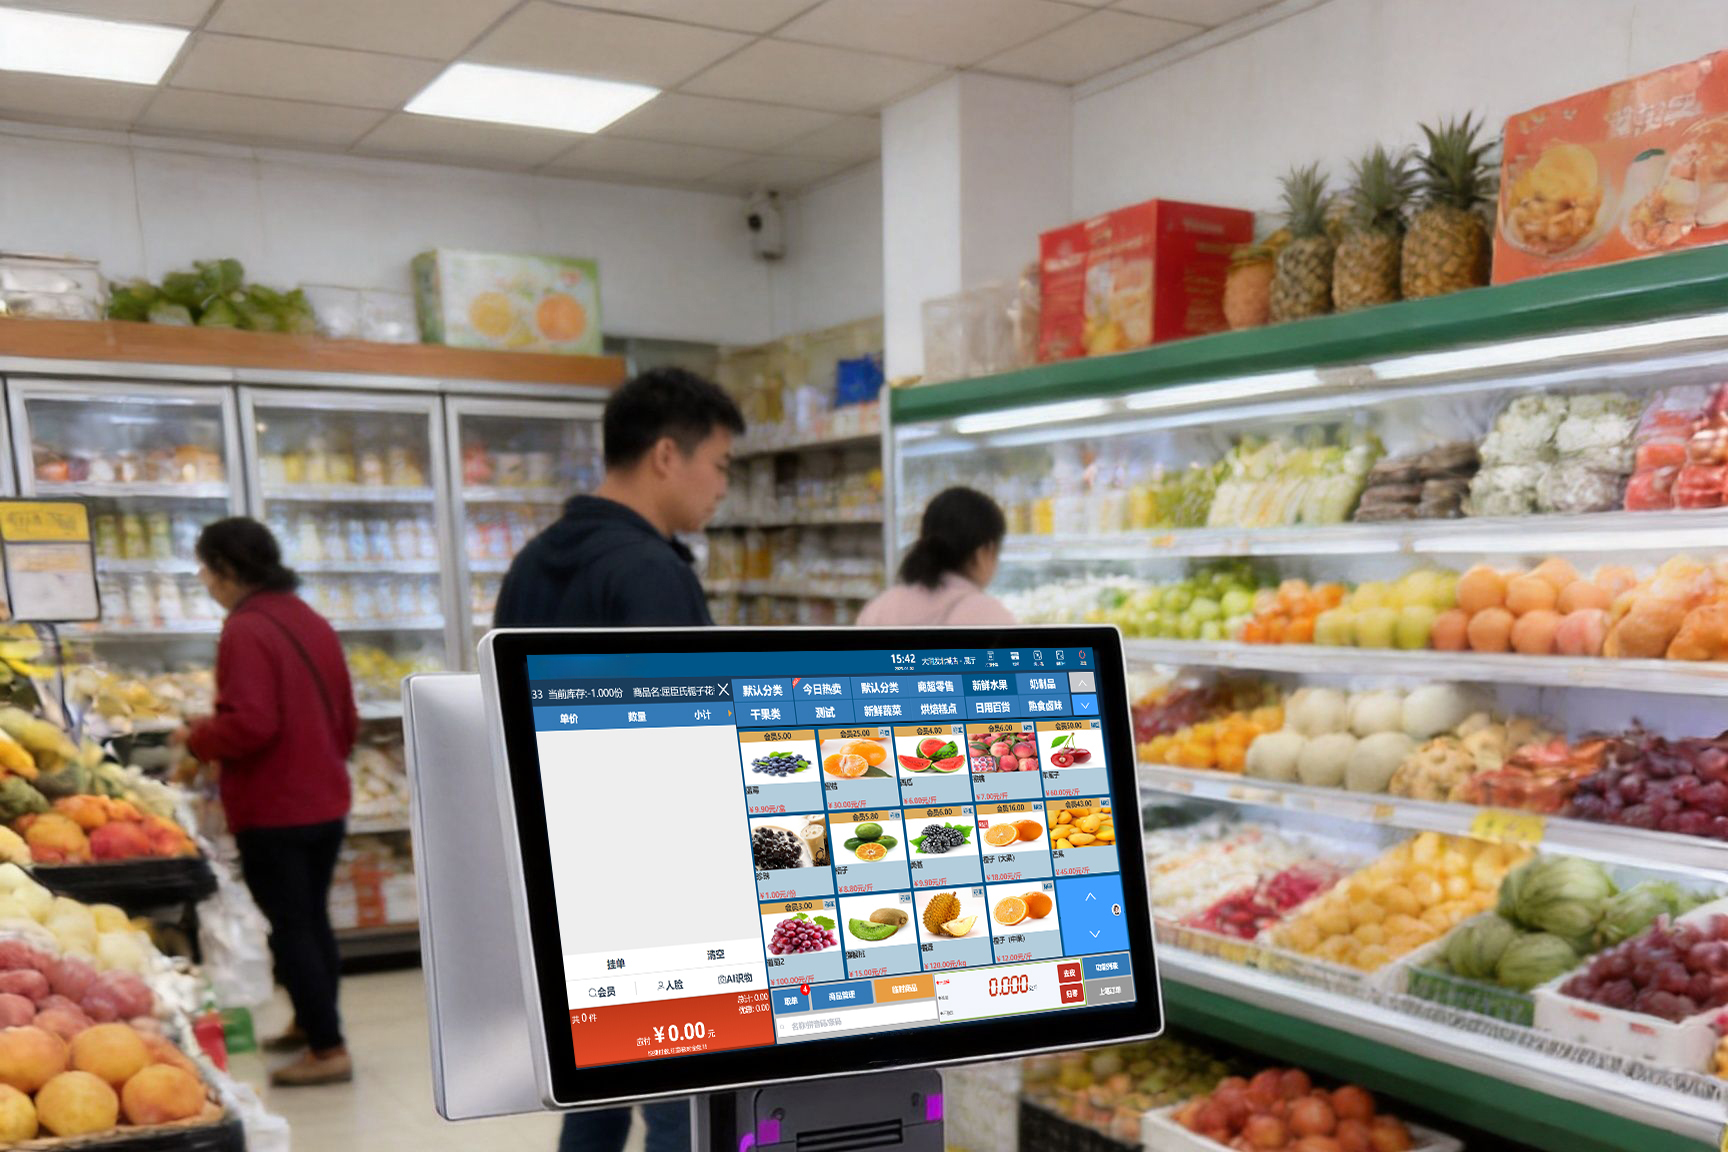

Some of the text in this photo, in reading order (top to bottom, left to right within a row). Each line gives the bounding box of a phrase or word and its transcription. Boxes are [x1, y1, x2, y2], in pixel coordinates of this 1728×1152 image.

[890, 654, 916, 664] 15:42
[802, 682, 842, 696] 今日热卖
[860, 682, 900, 694] 默认分类
[918, 680, 954, 693] 商超零售
[972, 679, 1008, 691] 新鲜水果
[1030, 678, 1056, 690] 奶制品
[548, 688, 624, 700] 当前库存:-1.000份
[632, 686, 716, 698] 商品名:屈臣氏栀子花
[742, 684, 784, 697] 默认分类
[815, 706, 836, 718] 测试
[864, 704, 902, 717] 新鲜蔬菜
[976, 701, 1010, 713] 日用百货
[560, 714, 578, 724] 单价
[628, 712, 647, 722] 数量
[694, 709, 712, 720] 小计
[750, 708, 781, 720] 干果类
[727, 972, 753, 984] AI识物
[666, 979, 684, 991] 人脸
[989, 974, 1028, 997] 0.000
[597, 986, 616, 998] 会员
[581, 1013, 587, 1023] 0
[588, 1013, 598, 1023] 件
[708, 1029, 716, 1038] 元
